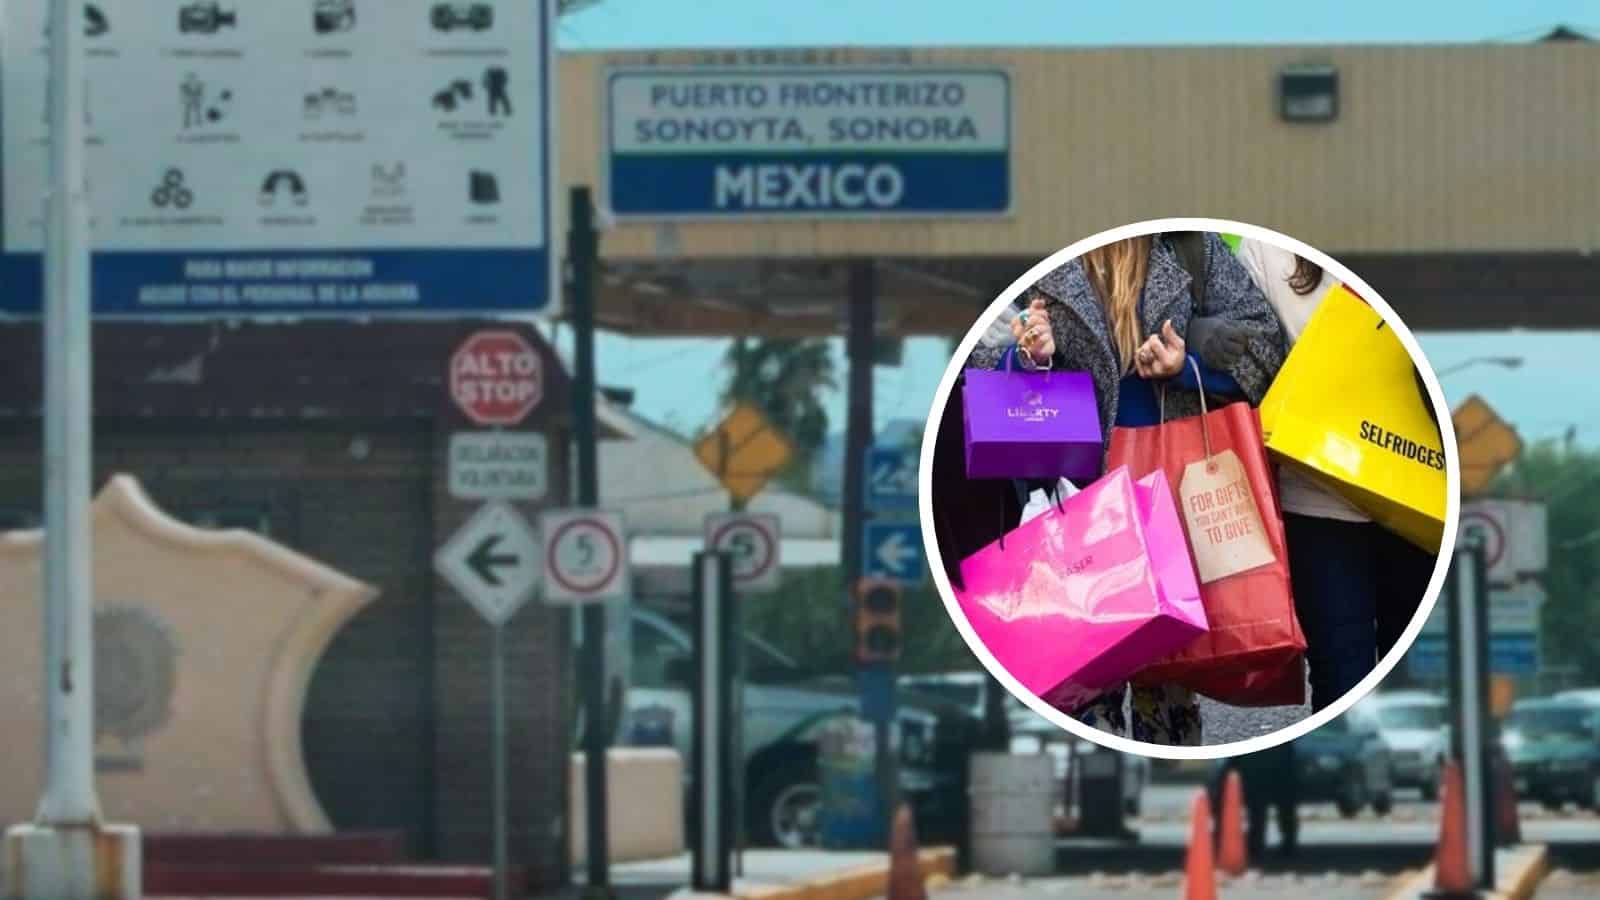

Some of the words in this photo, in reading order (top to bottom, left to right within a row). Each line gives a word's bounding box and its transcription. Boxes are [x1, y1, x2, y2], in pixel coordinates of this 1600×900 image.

[651, 83, 768, 108] PUERTO
[780, 82, 965, 108] FRONTERIZO
[634, 117, 815, 145] SONOYTA,
[828, 116, 979, 142] SONORA
[714, 163, 904, 208] MEXICO
[458, 352, 535, 376] ALTO
[458, 381, 538, 404] STOP
[1360, 419, 1445, 471] SELFRIDGES
[1190, 491, 1213, 512] FOR
[1204, 526, 1222, 544] TO
[1223, 517, 1252, 541] GIVE
